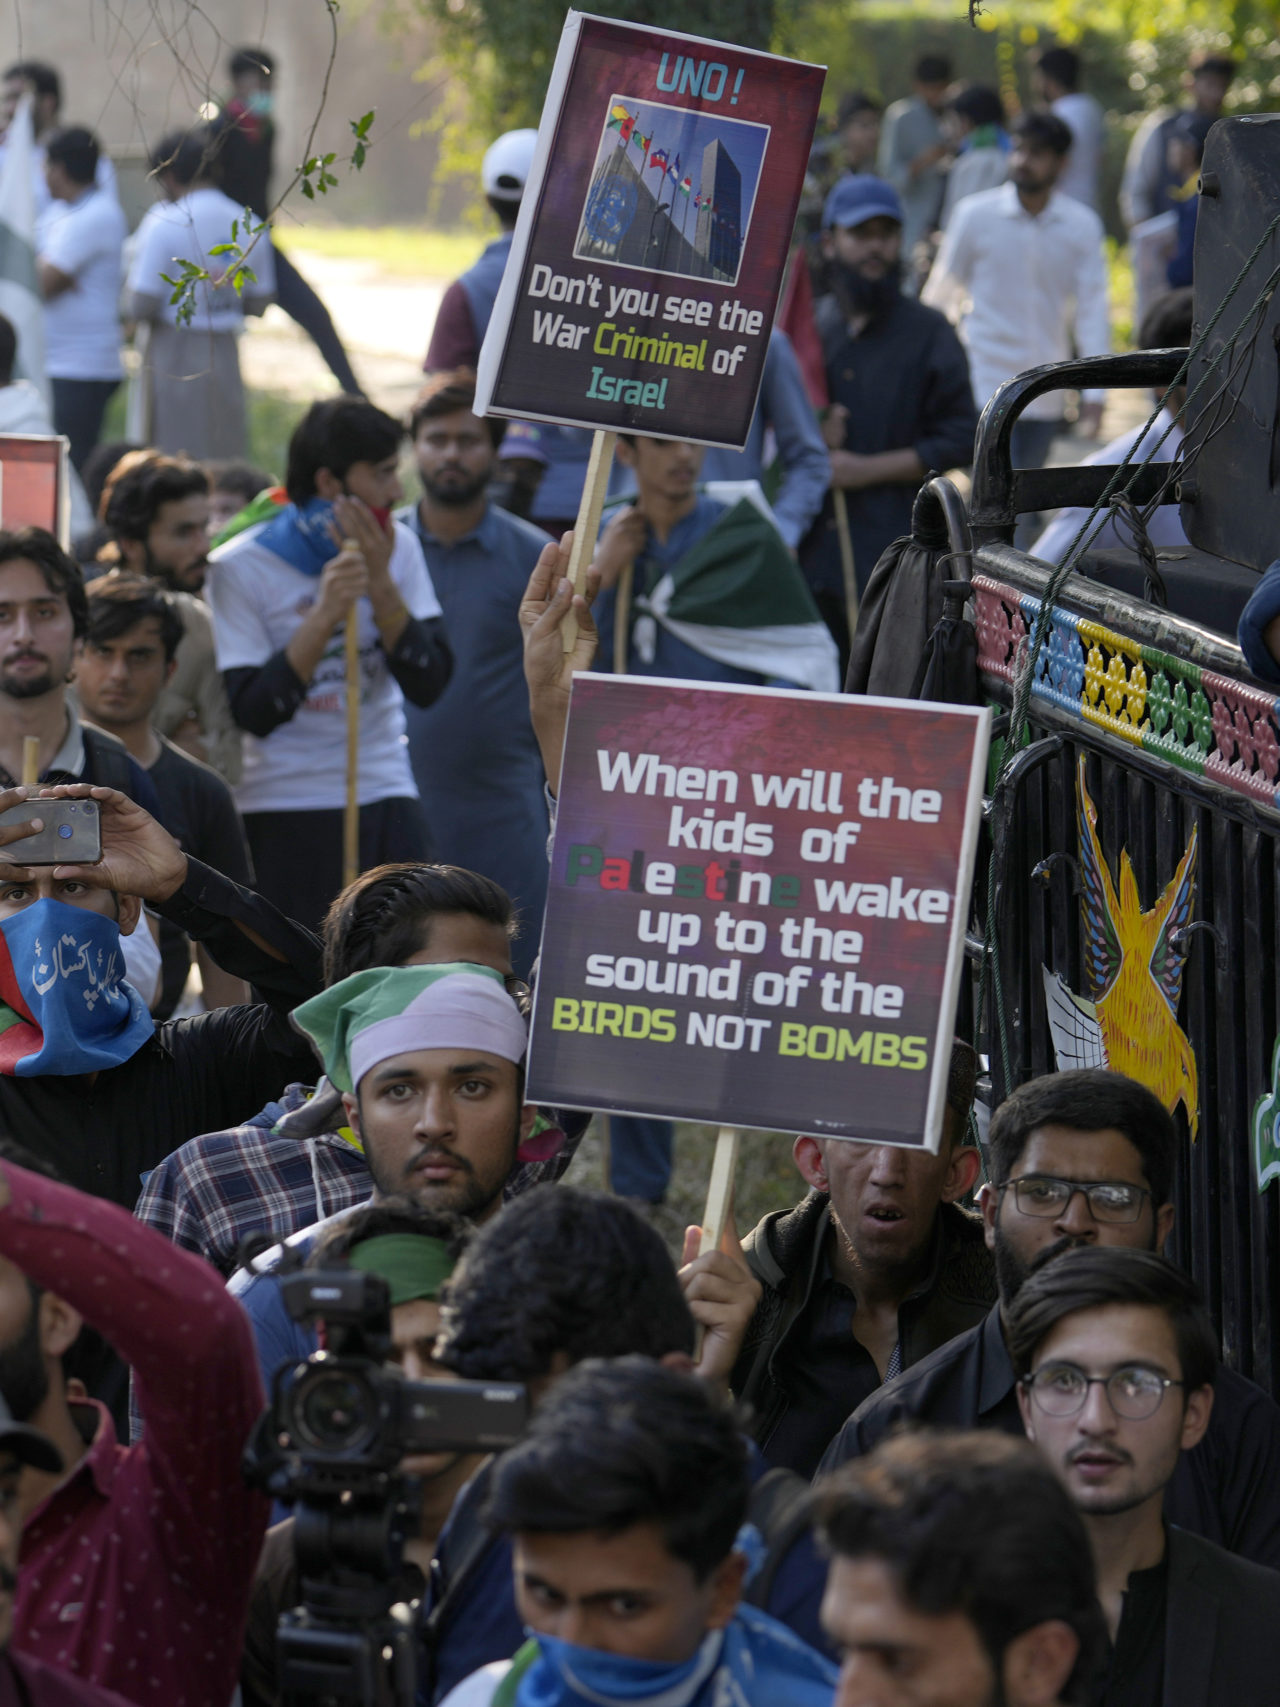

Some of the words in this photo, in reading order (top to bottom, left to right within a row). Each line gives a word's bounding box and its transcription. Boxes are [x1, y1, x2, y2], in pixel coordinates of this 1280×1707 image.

[527, 264, 602, 308] Don't
[604, 284, 660, 319] you
[662, 296, 713, 327] see
[718, 300, 764, 336] the
[532, 309, 590, 350] War
[593, 321, 708, 371] Criminal
[711, 345, 748, 376] of
[585, 366, 668, 410] Israel
[597, 749, 739, 804] When
[751, 768, 844, 815] will
[857, 776, 943, 824] the
[667, 805, 775, 857] kids
[800, 821, 861, 865] of
[564, 843, 802, 909] Palestine
[814, 876, 951, 924] wake
[637, 909, 702, 955] up
[714, 911, 767, 955] to
[779, 917, 864, 964] the
[585, 953, 742, 1001] sound
[752, 966, 813, 1008] of
[820, 971, 905, 1019] the
[551, 997, 677, 1043] BIRDS
[685, 1011, 772, 1053] NOT
[778, 1022, 929, 1071] BOMBS
